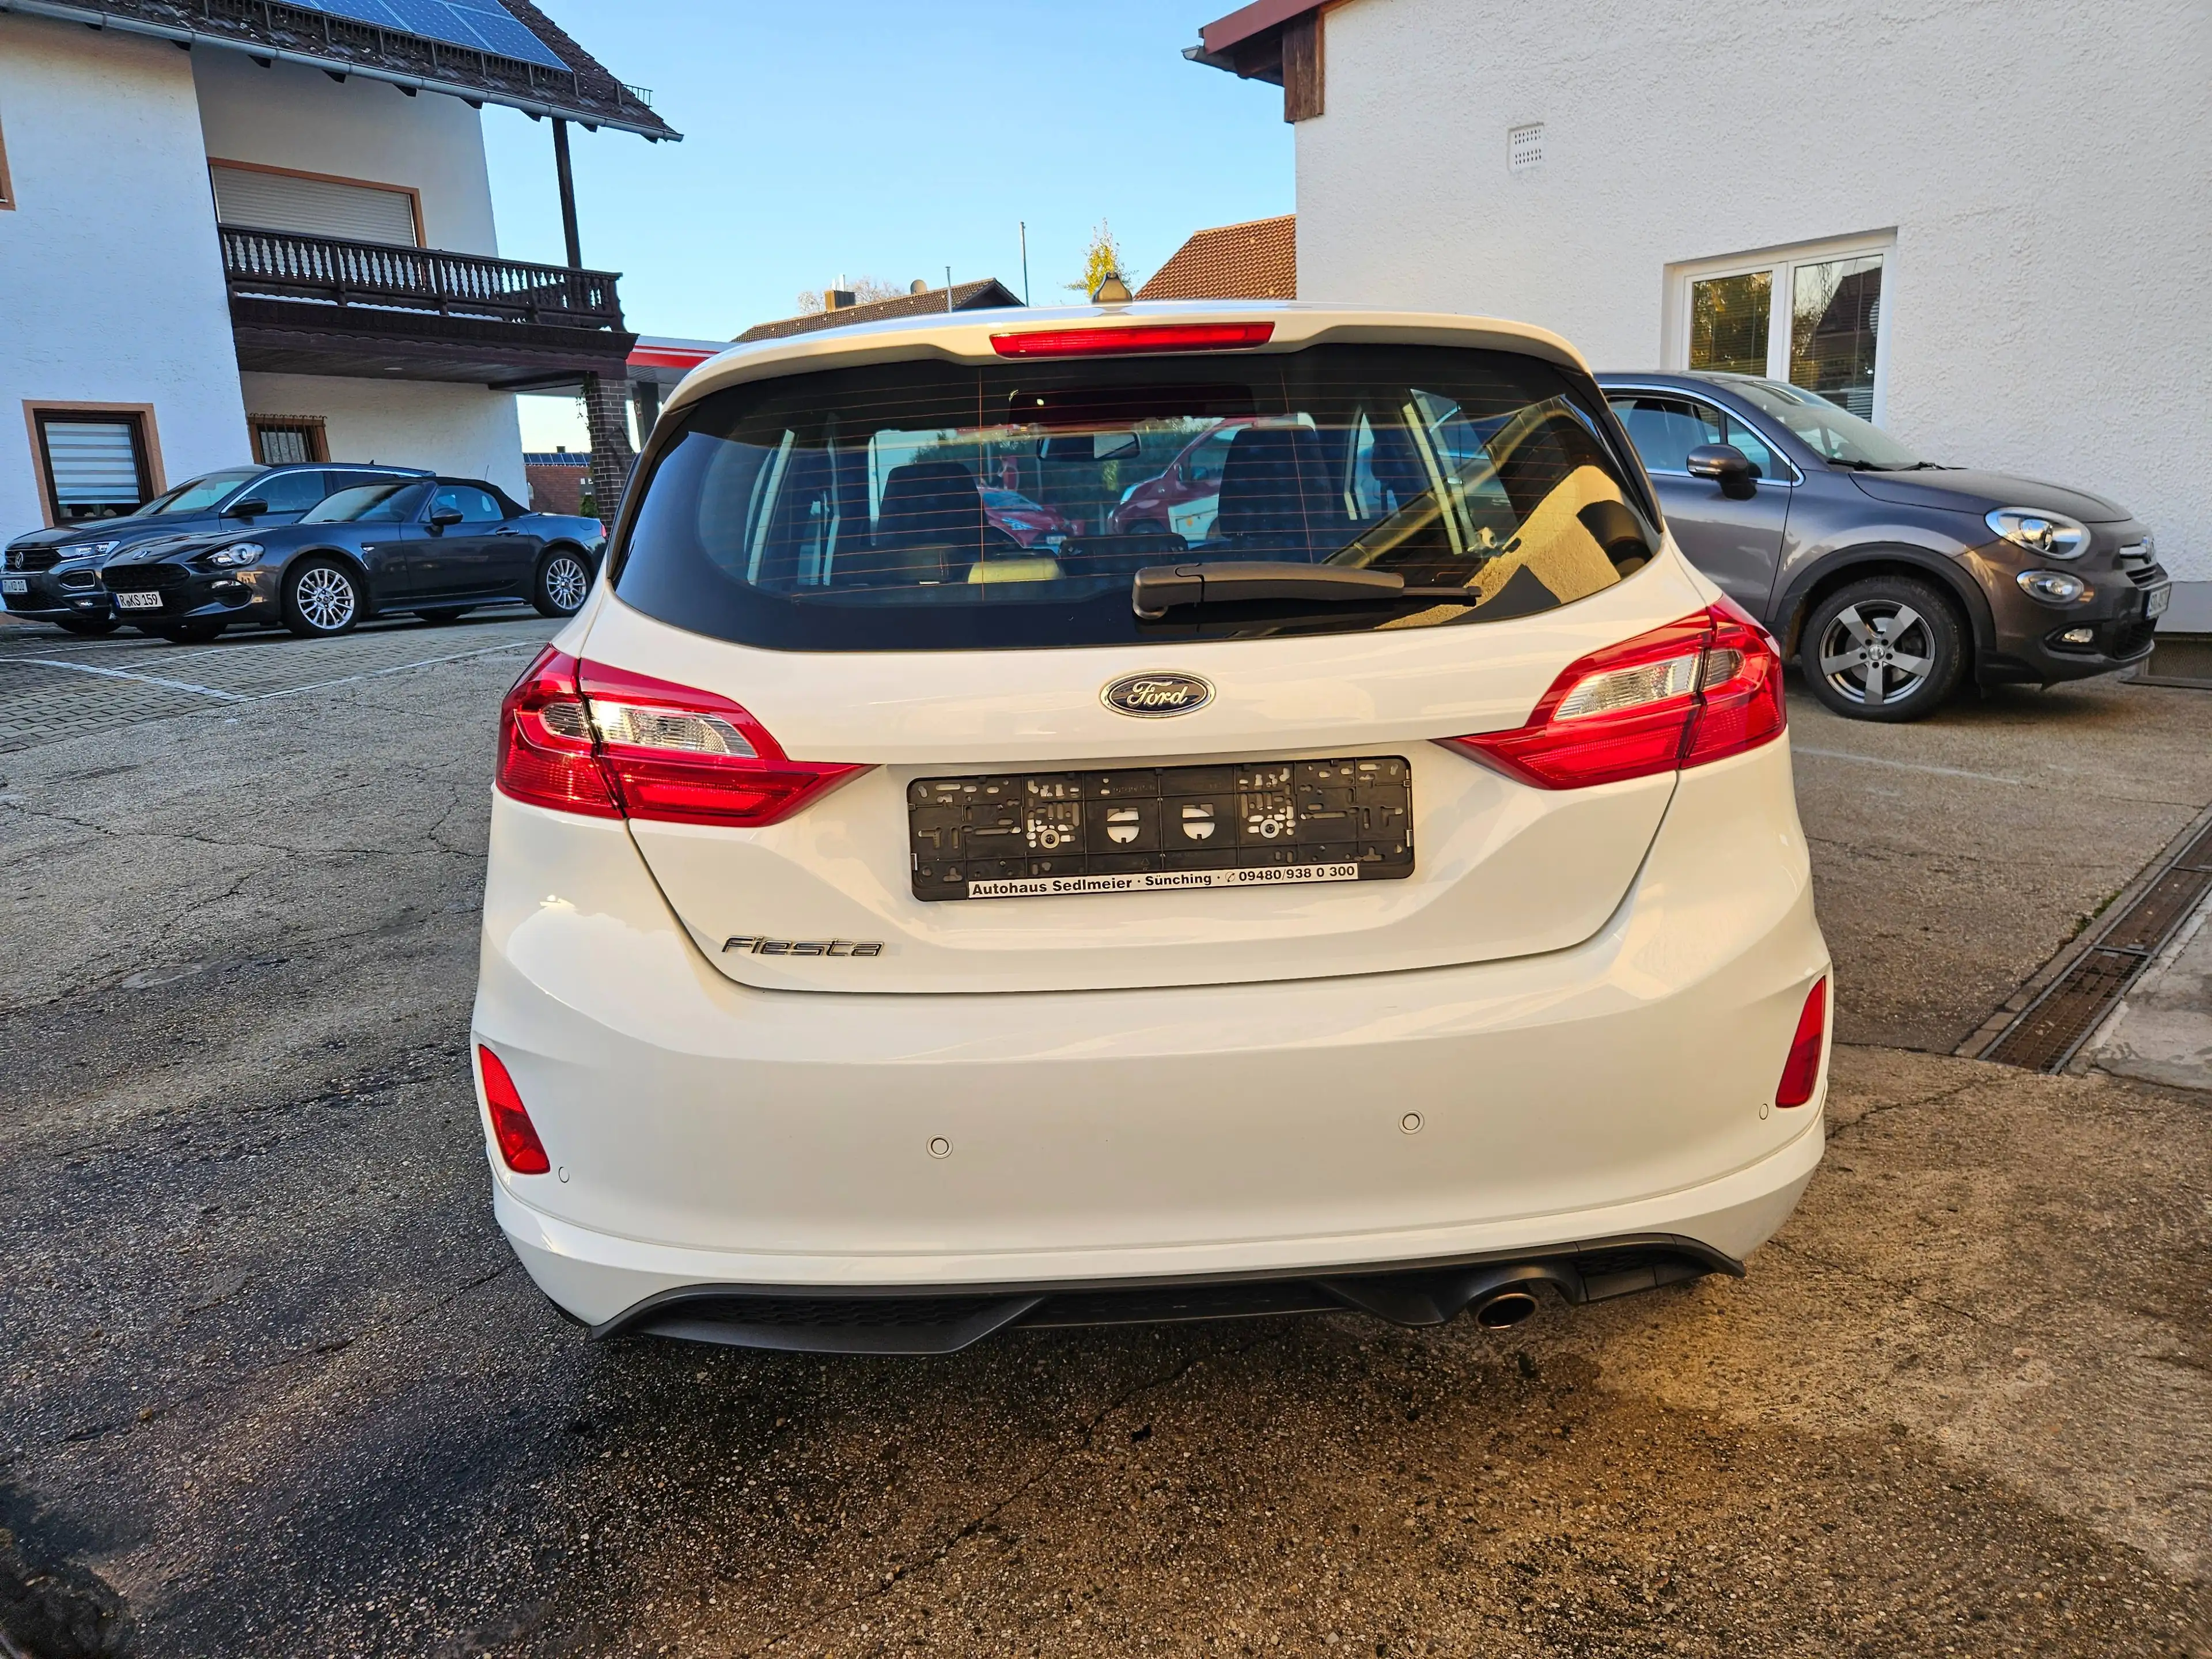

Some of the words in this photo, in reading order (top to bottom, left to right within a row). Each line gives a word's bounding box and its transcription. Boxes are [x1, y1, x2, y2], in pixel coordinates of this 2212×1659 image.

[119, 594, 127, 606] R
[128, 594, 141, 606] KS
[142, 593, 158, 605] 159
[1127, 681, 1188, 707] Ford
[972, 881, 1047, 895] Autohaus
[1052, 877, 1132, 892] Sedlmeier
[1145, 873, 1212, 887] Sünching
[1238, 868, 1312, 881] 09480/938
[1316, 867, 1325, 877] 0
[1329, 865, 1355, 877] 300
[721, 935, 884, 957] Fiesta
